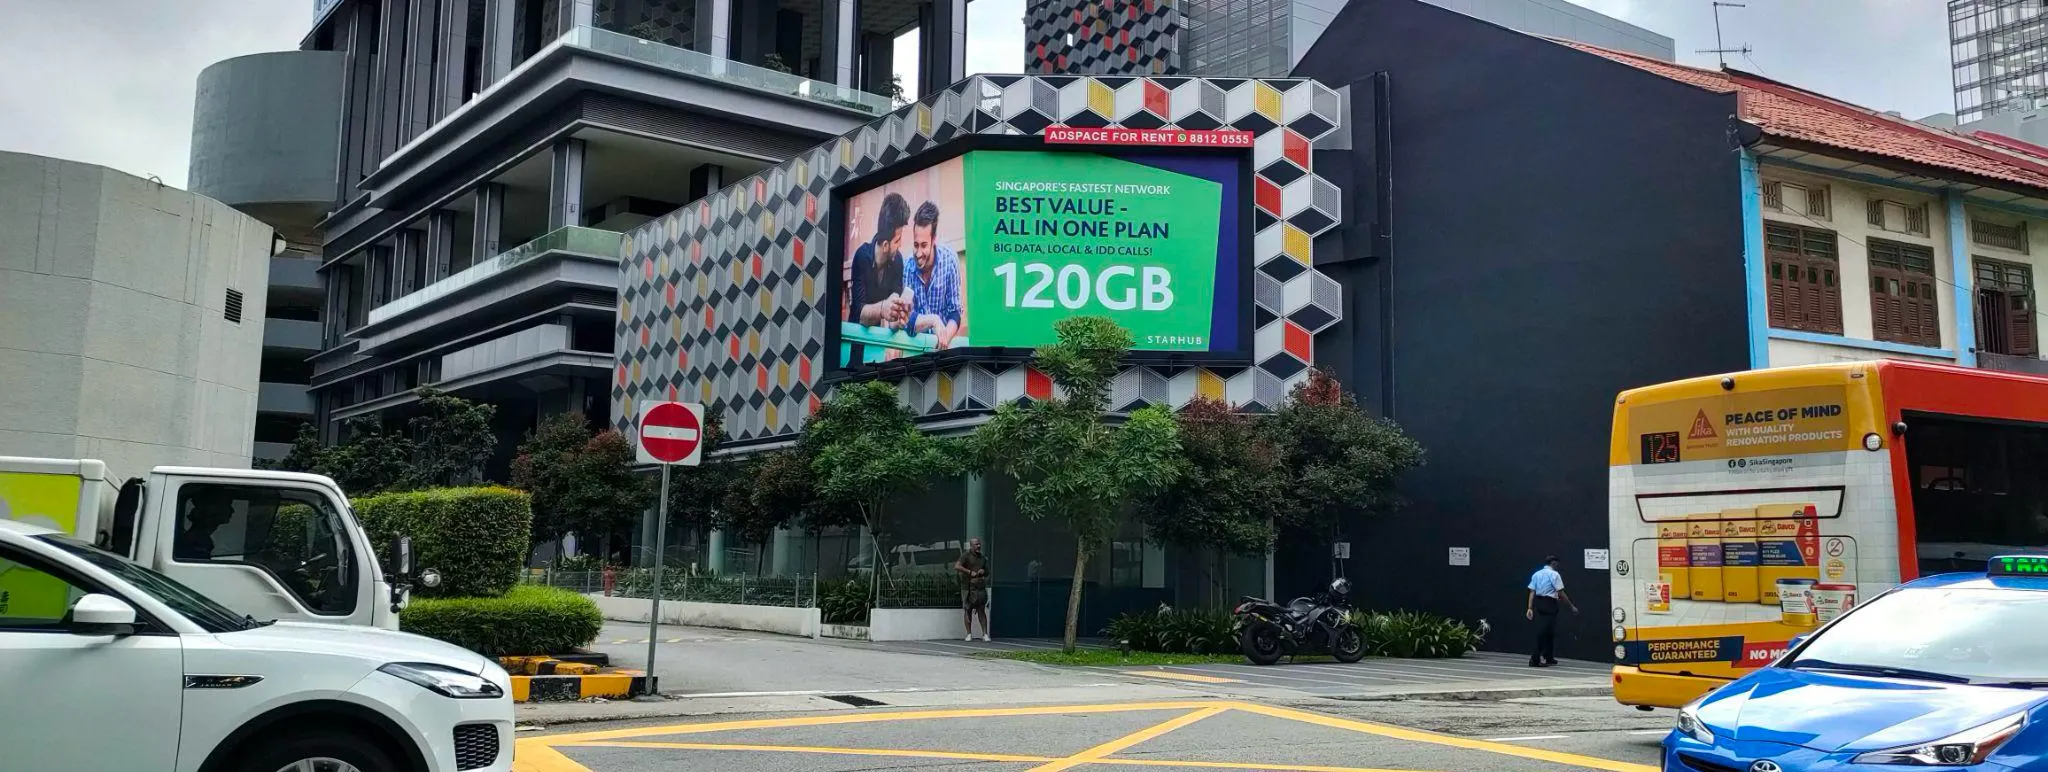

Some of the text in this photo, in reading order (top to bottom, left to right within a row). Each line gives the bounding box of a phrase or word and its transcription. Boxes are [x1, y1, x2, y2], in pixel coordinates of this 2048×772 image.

[1050, 130, 1249, 144] ADSPACE FOR RENT 8812 0555
[995, 181, 1171, 195] SINGAPORE'S FASTEST NETWORK
[995, 196, 1042, 214] BEST
[1048, 198, 1114, 215] VALUE
[994, 218, 1169, 239] ALL IN ONE PLAN
[994, 243, 1152, 256] BIG DATA, LOCAL & IDD CALLS!
[993, 262, 1174, 311] 120GB
[1147, 335, 1203, 345] STARHUB
[1725, 404, 1842, 426] PEACE OF MIND
[1690, 417, 1714, 437] Sika
[1726, 423, 1796, 437] WITH QUALITY
[1726, 434, 1785, 447] RENOVATION
[1788, 430, 1844, 443] PRODUCTS
[1649, 433, 1678, 463] 125
[1617, 562, 1628, 571] 60
[1648, 639, 1720, 651] PERFORMANCE
[1651, 650, 1717, 661] GUARANTEED
[1749, 648, 1789, 660] NO MO
